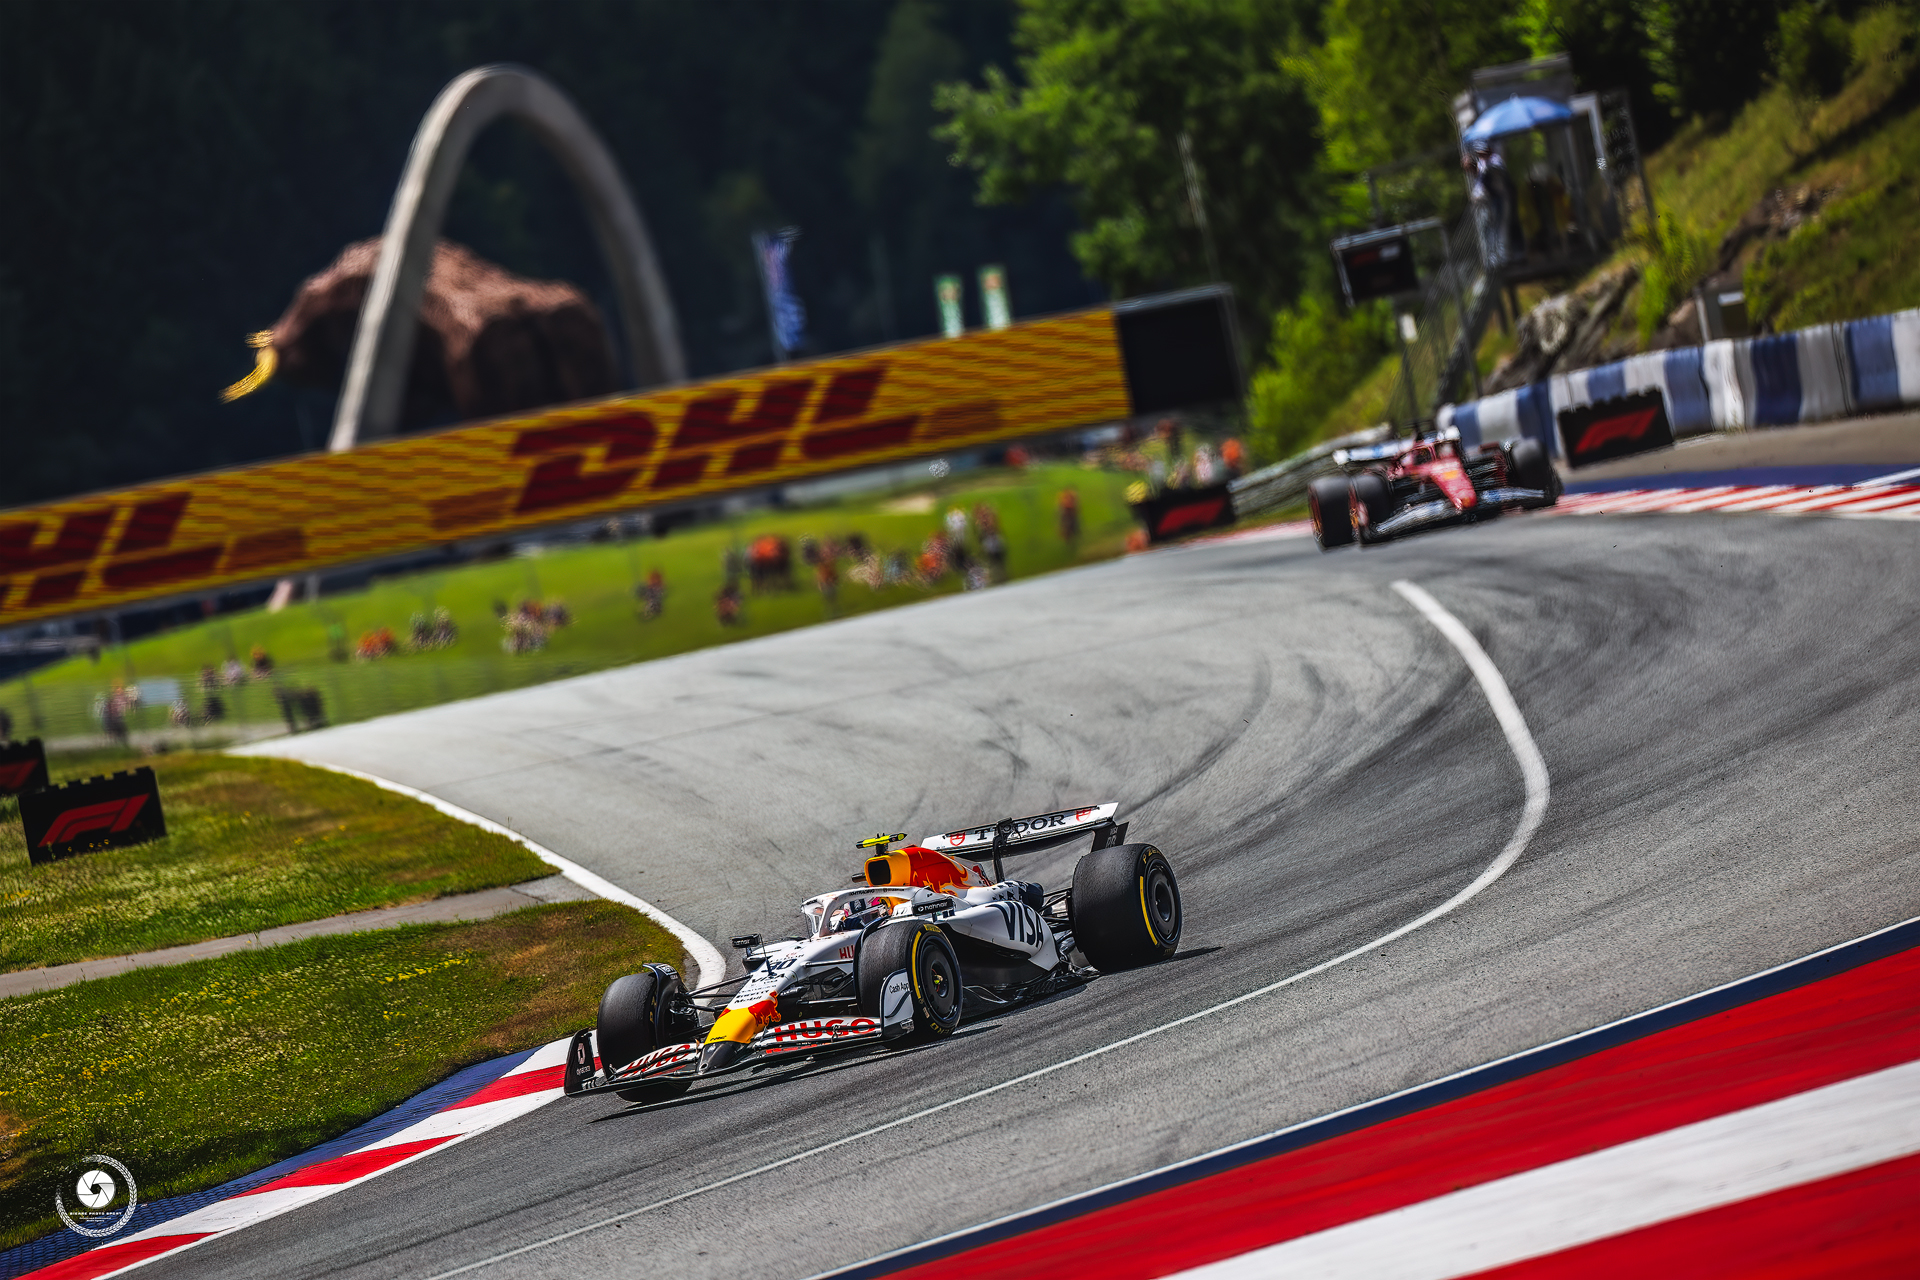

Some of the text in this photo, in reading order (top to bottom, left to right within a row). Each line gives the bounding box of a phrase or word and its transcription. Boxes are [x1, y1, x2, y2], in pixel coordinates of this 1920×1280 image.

[513, 368, 919, 516] DHL
[38, 793, 149, 848] F1
[975, 813, 1067, 842] TDOR
[985, 901, 1044, 948] VISA
[889, 983, 900, 994] Cash
[774, 1018, 876, 1042] HUGO
